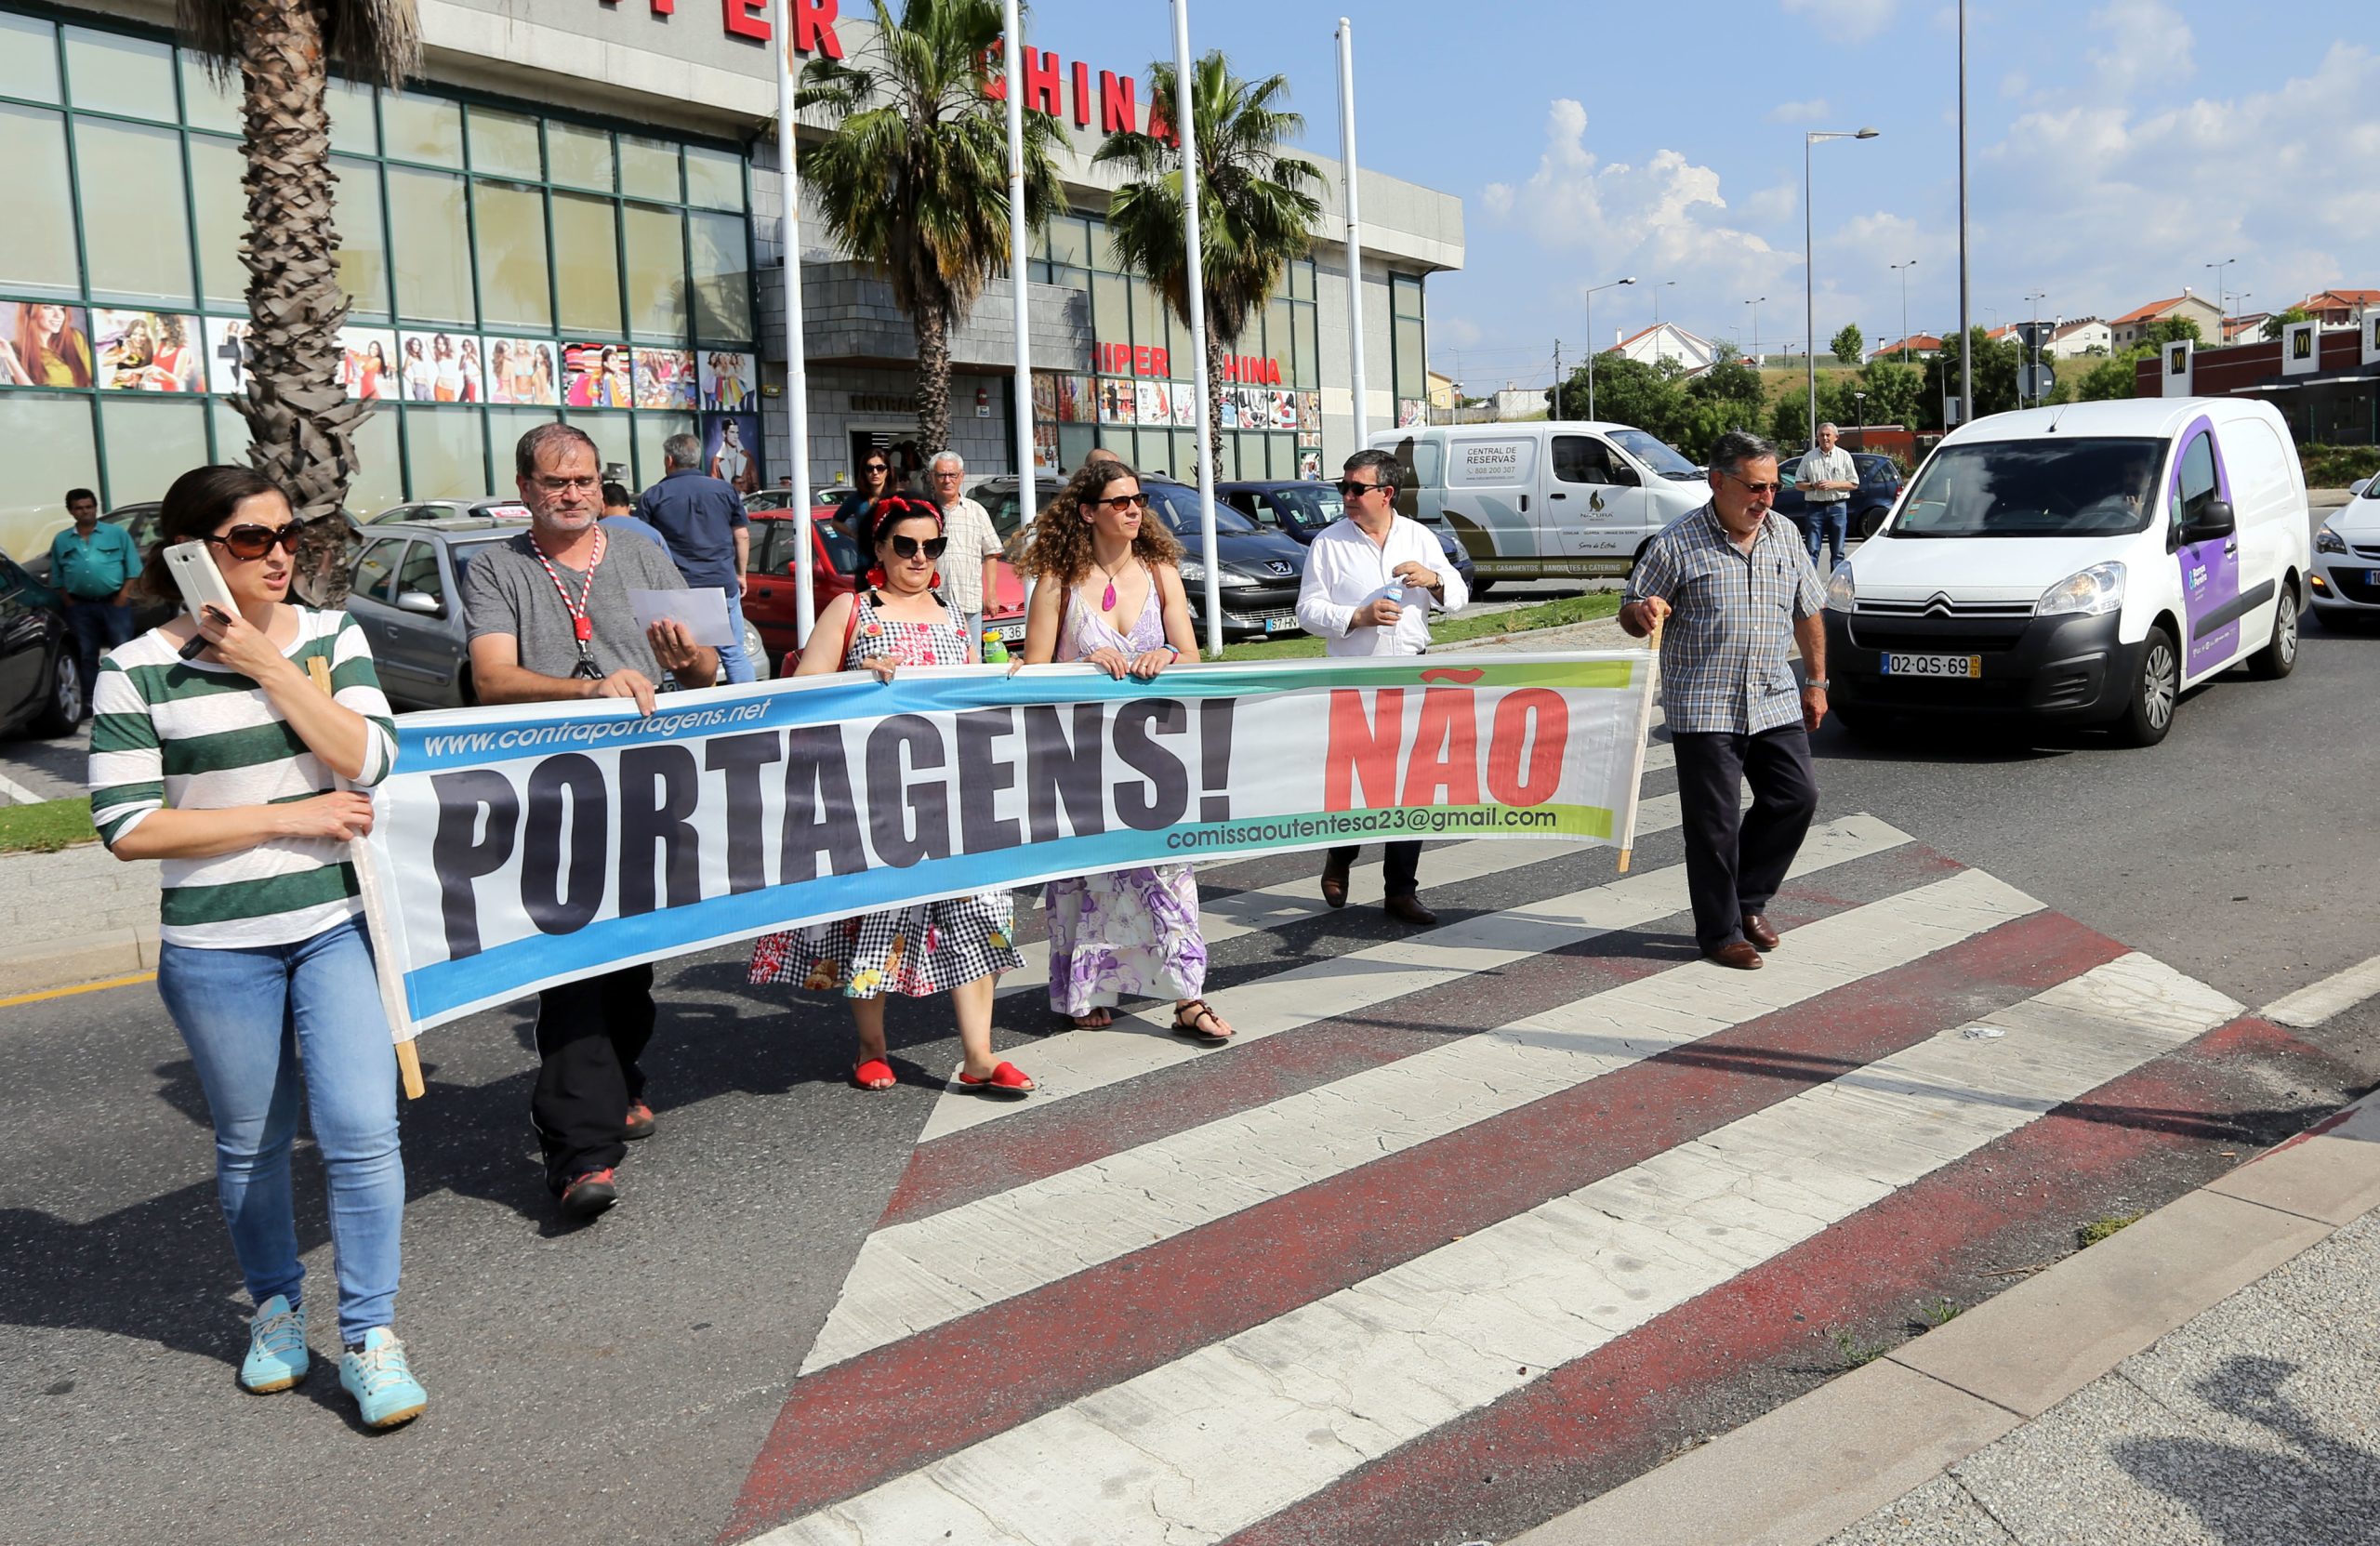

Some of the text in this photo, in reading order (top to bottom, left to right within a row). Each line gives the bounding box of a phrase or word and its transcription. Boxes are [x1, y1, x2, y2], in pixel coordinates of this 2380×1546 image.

[1223, 353, 1282, 385] HINA
[1466, 455, 1516, 464] RESERVAS
[1467, 446, 1517, 456] CENTRAL DE
[1474, 467, 1488, 475] 808
[1502, 466, 1516, 474] 307
[1588, 563, 1621, 572] CATERING
[424, 699, 772, 758] www.contraportagens.net
[430, 667, 1569, 961] PORTAGENS! NÃO
[1166, 806, 1557, 850] comissaoutentesa23@gmail.com
